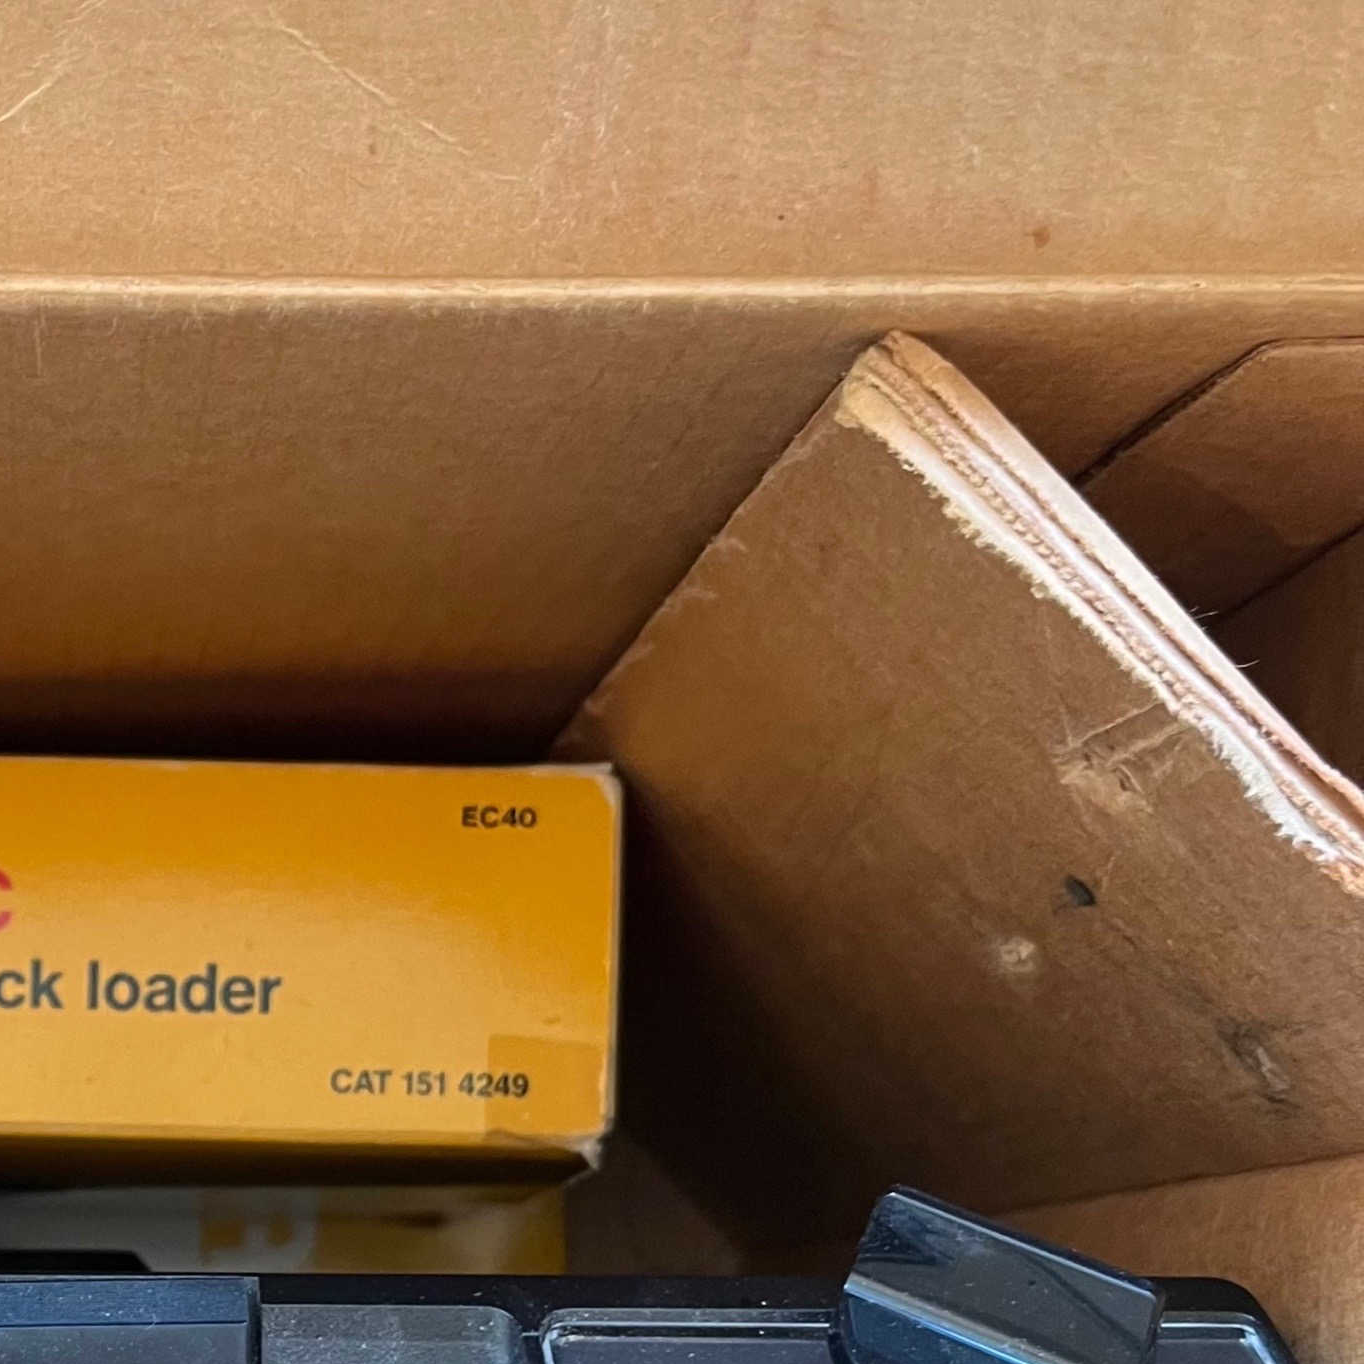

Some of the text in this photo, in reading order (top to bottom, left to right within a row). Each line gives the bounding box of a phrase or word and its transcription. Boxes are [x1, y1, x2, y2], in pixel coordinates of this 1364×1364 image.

[461, 805, 537, 829] EC40
[86, 958, 283, 1016] loader
[329, 1067, 531, 1099] CAT 151 4249
